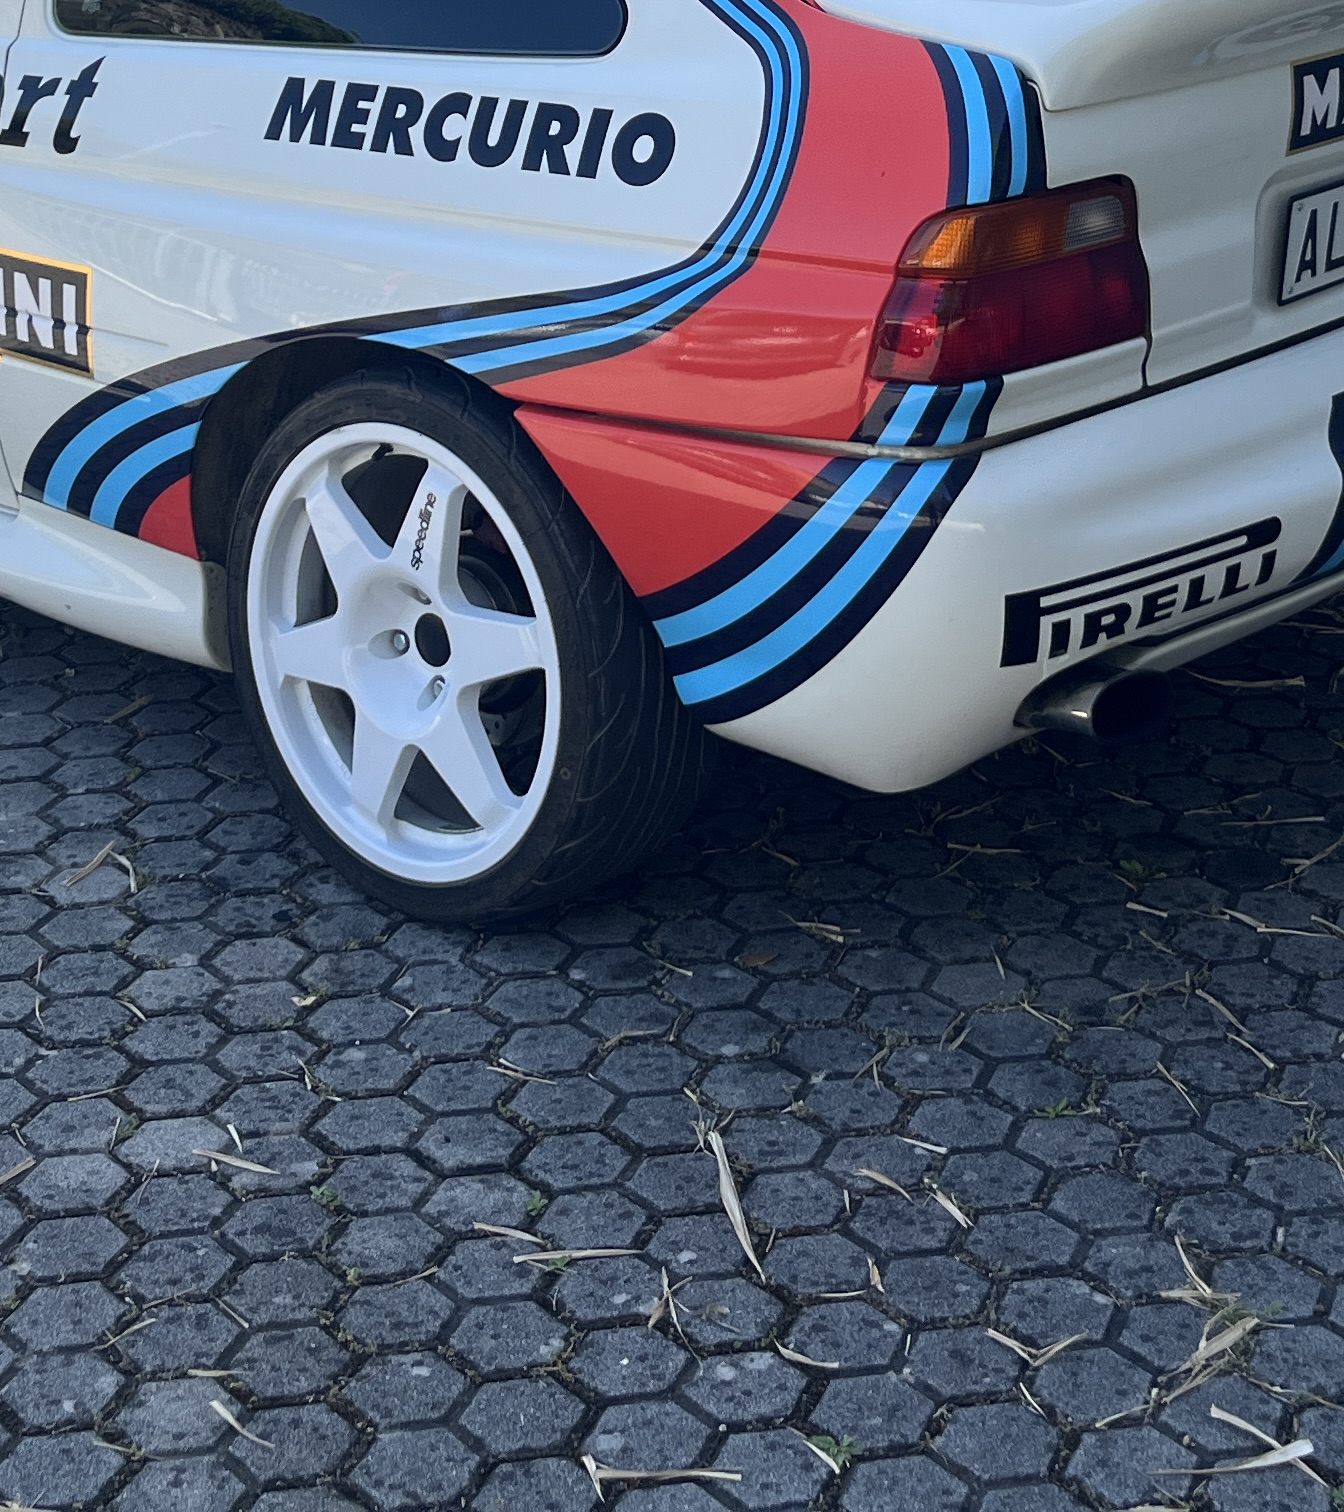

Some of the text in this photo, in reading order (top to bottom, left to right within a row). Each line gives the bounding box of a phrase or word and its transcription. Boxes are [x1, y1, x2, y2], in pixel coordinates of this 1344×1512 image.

[263, 76, 676, 187] MERCURIO
[410, 492, 437, 571] speedline
[999, 515, 1283, 668] PIRELLI
